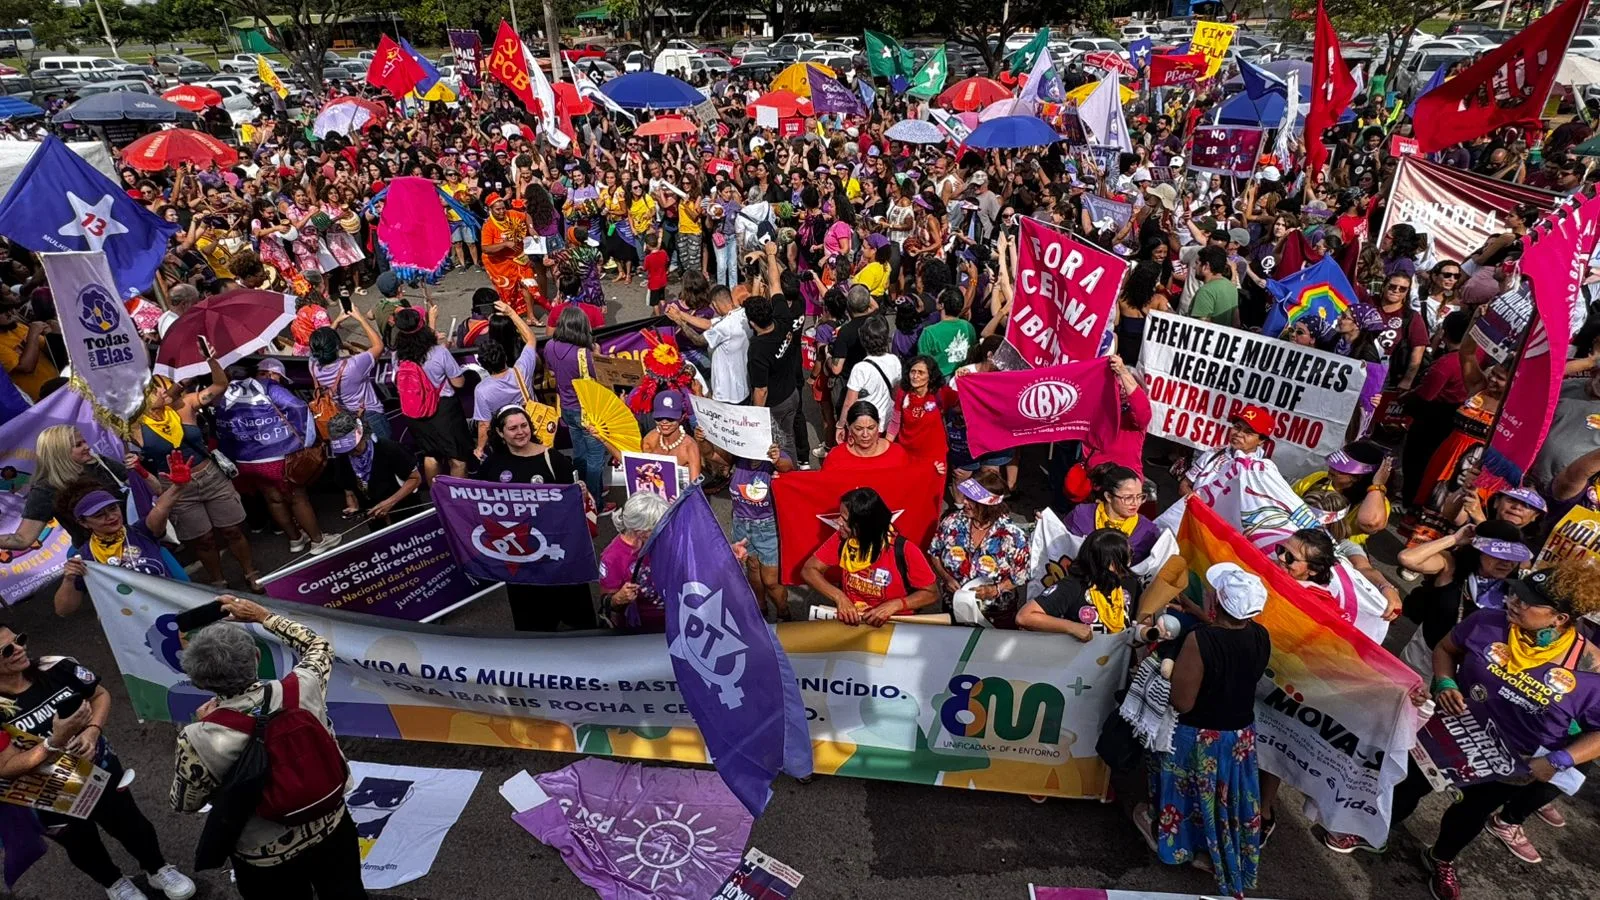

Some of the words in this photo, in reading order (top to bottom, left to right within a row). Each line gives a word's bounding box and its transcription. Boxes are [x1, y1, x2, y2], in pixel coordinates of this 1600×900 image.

[1202, 27, 1224, 40] FIM
[491, 51, 530, 91] PCB
[81, 212, 107, 237] 13
[1400, 199, 1476, 230] CONTRA
[1485, 209, 1497, 232] A
[1030, 236, 1106, 295] FORA
[1021, 268, 1098, 338] CELINA
[83, 333, 130, 350] Todas
[87, 351, 98, 367] POR
[95, 347, 134, 366] Elas
[1147, 316, 1216, 355] FRENTE
[1214, 331, 1242, 363] DE
[1240, 339, 1353, 393] MULHERES
[1144, 373, 1209, 416] CONTRA
[1212, 394, 1226, 420] O
[1169, 352, 1245, 395] NEGRAS
[1244, 373, 1275, 403] DO
[1274, 380, 1305, 412] DF
[695, 400, 723, 422] Lugar
[728, 412, 761, 428] mulher
[1021, 385, 1072, 418] UBM
[254, 432, 271, 442] do
[273, 427, 290, 439] PT
[721, 426, 741, 438] onde
[1162, 409, 1176, 433] E
[1175, 416, 1190, 439] O
[720, 436, 747, 448] quiser
[449, 486, 563, 502] MULHERES
[477, 502, 509, 516] DO
[513, 503, 540, 517] PT
[491, 532, 526, 554] PT
[297, 558, 369, 595] Comissão
[370, 550, 390, 564] de
[389, 526, 446, 555] Mulhere
[330, 580, 351, 595] do
[351, 544, 433, 585] Sindireceita
[342, 576, 387, 602] Nacional
[387, 571, 405, 583] das
[405, 549, 451, 574] Mulheres
[364, 596, 374, 605] 8
[374, 591, 389, 602] de
[389, 575, 420, 595] março
[395, 584, 427, 610] juntas
[426, 563, 457, 586] somos
[421, 577, 452, 599] fortes
[684, 613, 725, 660] PT
[352, 658, 414, 677] VIDA
[420, 663, 468, 684] DAS
[476, 668, 610, 692] MULHERES:
[1486, 662, 1551, 707] Revolução
[382, 679, 444, 698] FORA
[448, 689, 542, 709] IBANEIS
[549, 699, 636, 714] ROCHA
[643, 703, 656, 714] E
[1018, 746, 1061, 759] ENTORNO
